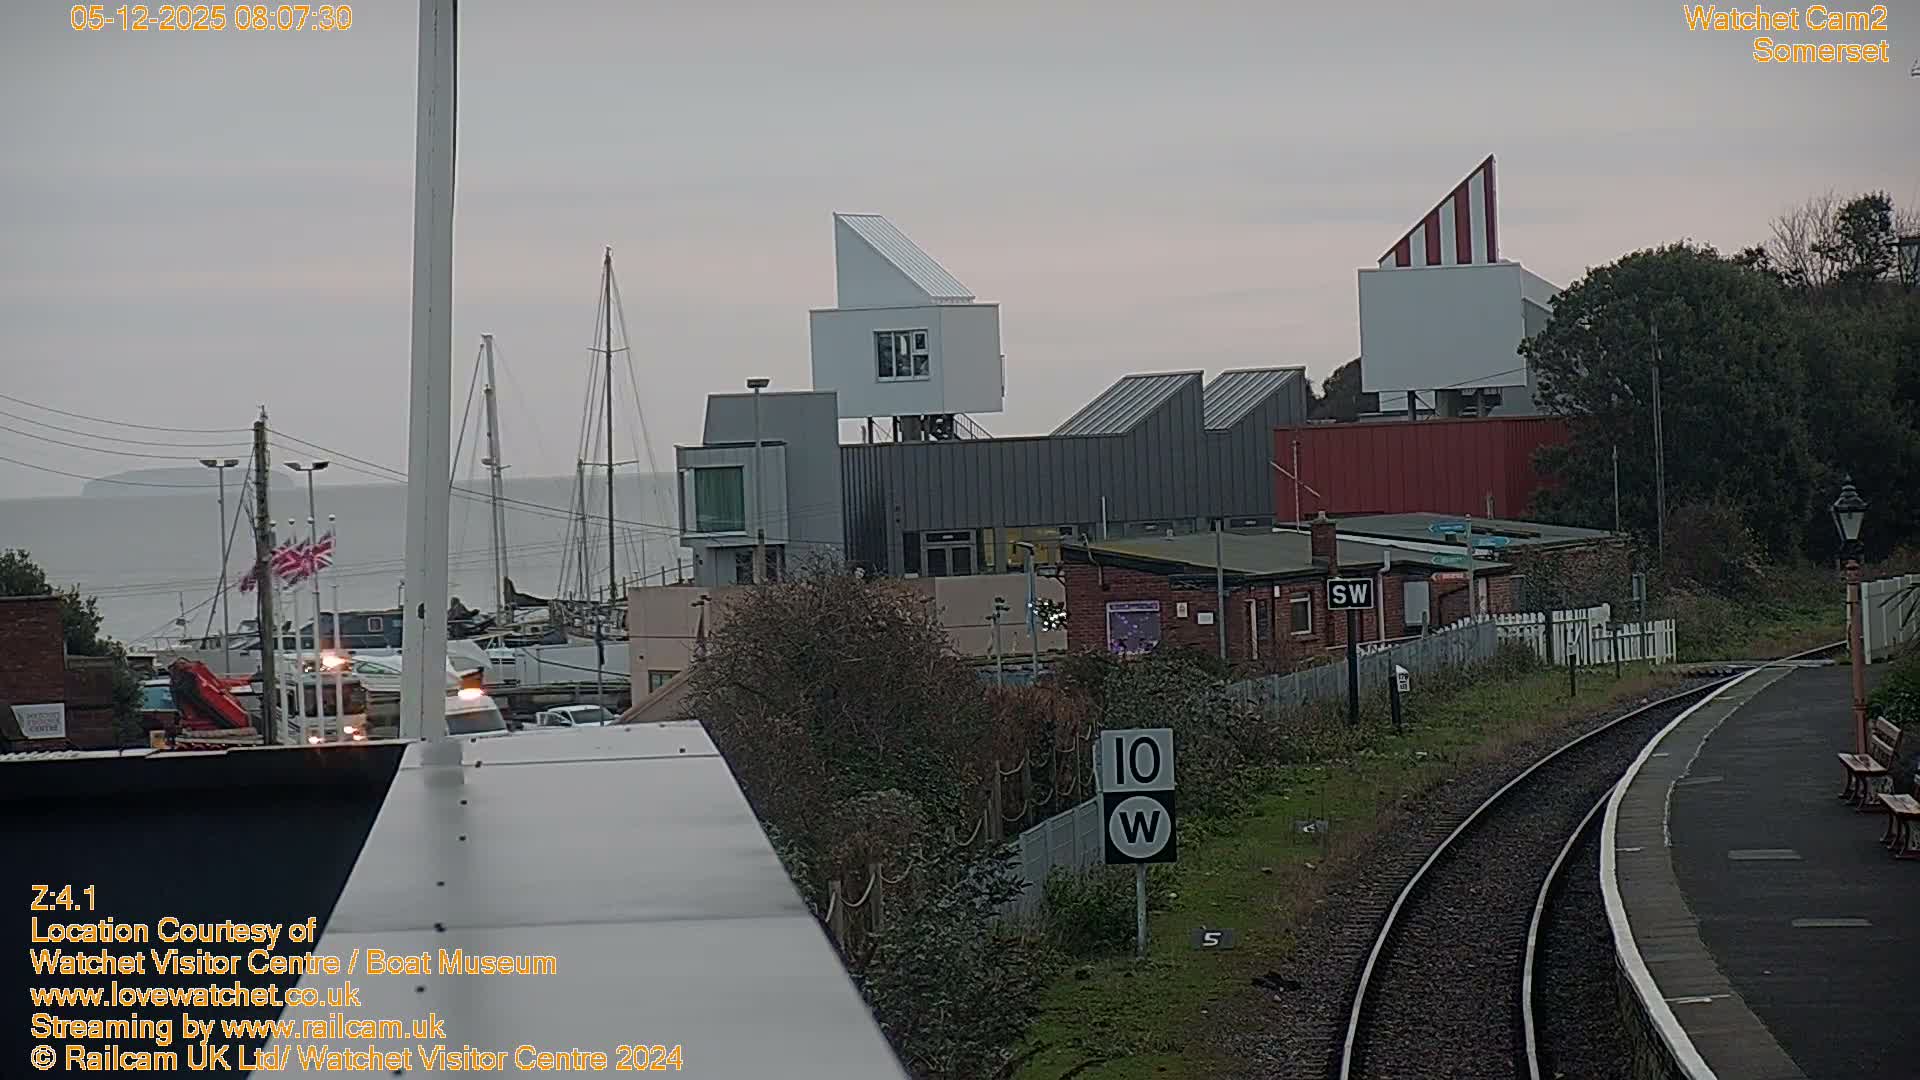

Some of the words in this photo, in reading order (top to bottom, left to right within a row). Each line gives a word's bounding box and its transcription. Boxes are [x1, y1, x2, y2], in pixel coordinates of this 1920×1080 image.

[1332, 583, 1369, 606] SW
[1115, 736, 1161, 785] 10
[1119, 810, 1161, 844] W
[1202, 931, 1222, 947] 5
